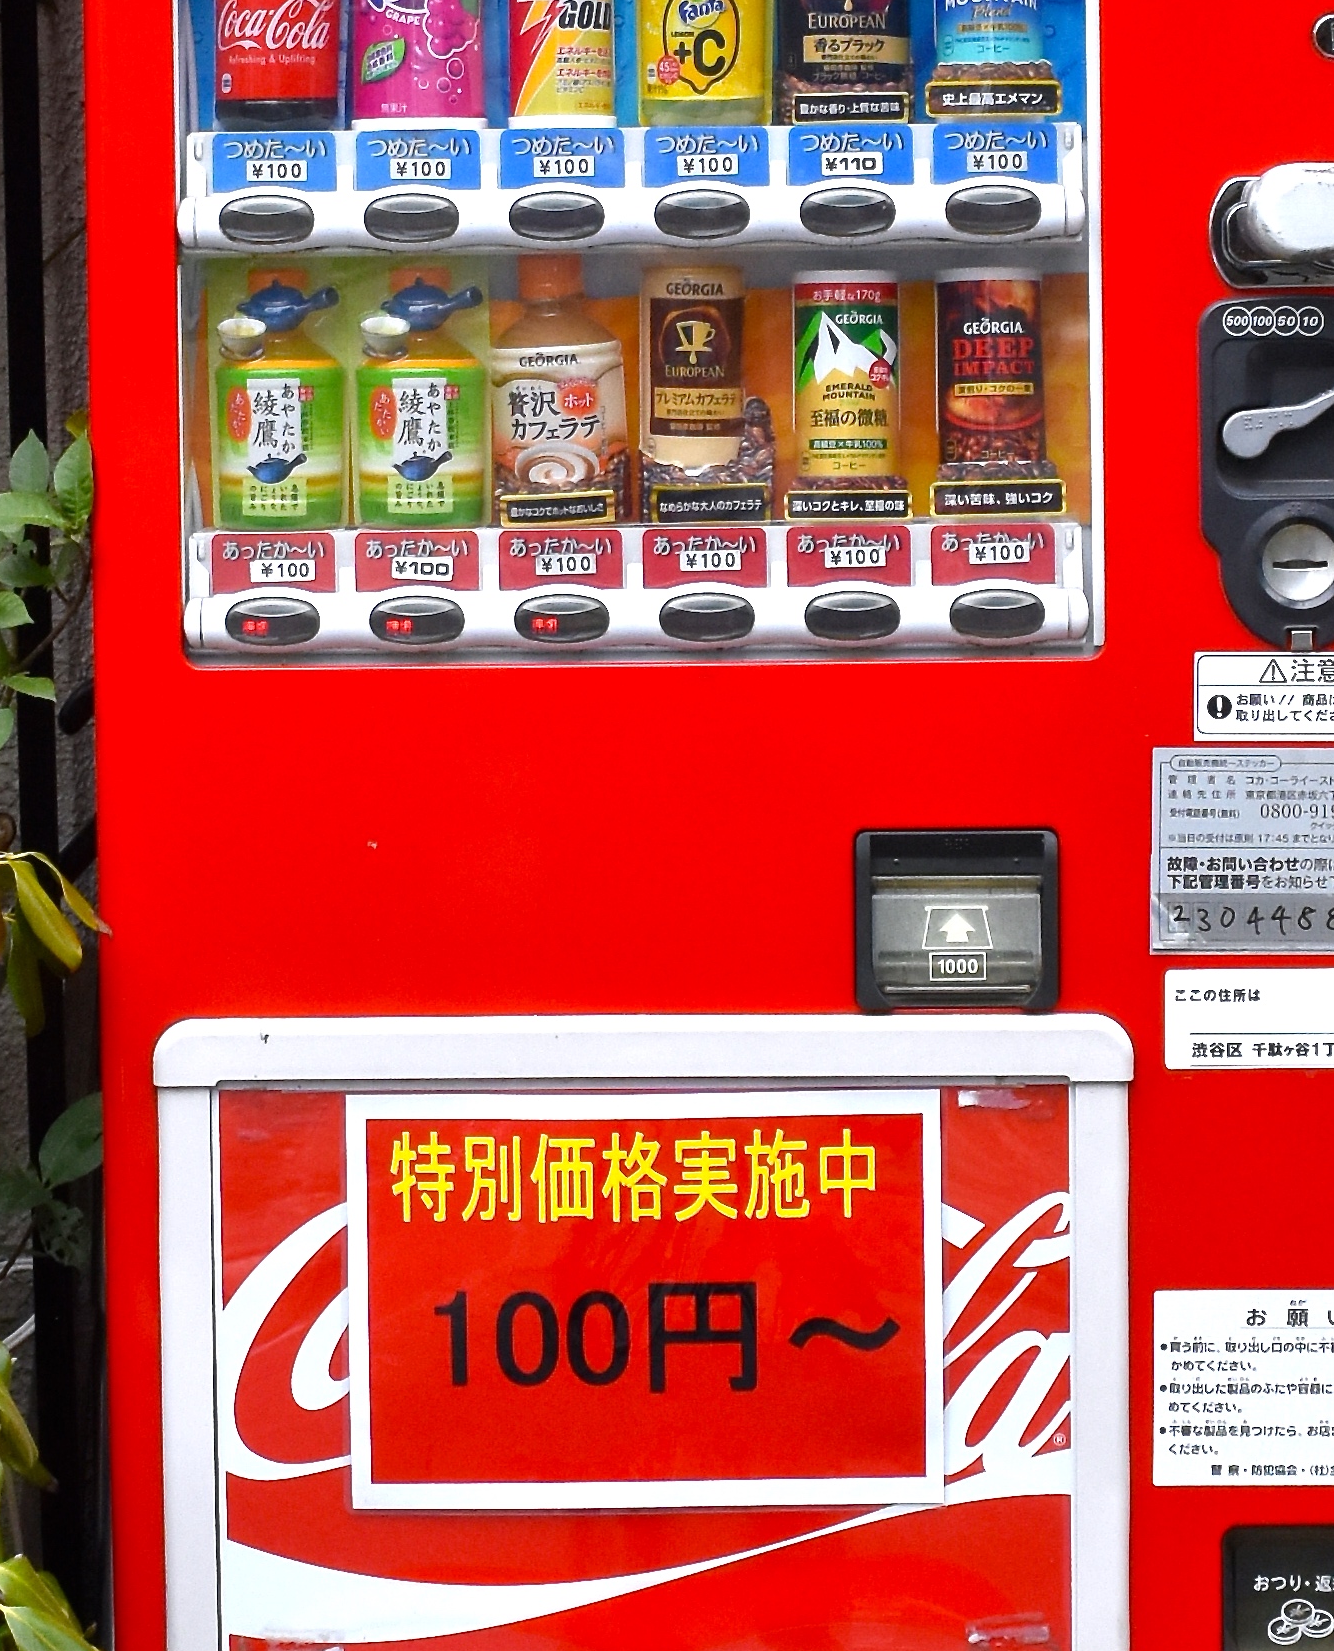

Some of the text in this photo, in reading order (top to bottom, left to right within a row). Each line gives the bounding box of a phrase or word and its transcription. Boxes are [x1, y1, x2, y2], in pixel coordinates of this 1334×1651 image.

[385, 8, 421, 26] GRAPE
[558, 0, 611, 31] GOLD
[807, 12, 886, 30] EUROPEAN
[268, 55, 276, 64] &
[278, 54, 316, 66] Uplifting
[396, 161, 446, 177] ¥100
[539, 159, 590, 175] ¥100
[683, 157, 734, 173] ¥100
[825, 156, 877, 172] ¥110
[973, 154, 1023, 170] ¥100
[252, 163, 302, 179] ¥100
[1226, 315, 1319, 328] 500 100 50 10
[952, 337, 1035, 360] DEEP
[665, 364, 726, 378] EUROPEAN
[953, 360, 1035, 377] IMPACT
[825, 382, 874, 392] EMERALD
[564, 392, 595, 408] ホット
[656, 392, 737, 406] プレミアムカフェラテ
[822, 391, 876, 401] MOUNTAIN
[508, 390, 562, 419] 贅沢
[252, 389, 281, 449] 綾鷹
[280, 383, 296, 455] あやたか
[398, 387, 427, 447] 綾鷹
[427, 382, 443, 453] あやたか
[810, 408, 889, 428] 至福の微糖
[511, 414, 601, 441] カフェラテ
[980, 450, 1015, 459] コーヒー
[832, 461, 866, 470] コーヒー
[659, 500, 763, 514] なめらかな大人のカフェラテ
[685, 553, 737, 569] ¥100
[830, 549, 880, 565] ¥100
[975, 545, 1026, 562] ¥100
[261, 563, 310, 578] ¥100
[395, 562, 450, 576] ¥100
[541, 557, 592, 573] ¥100
[1257, 834, 1290, 843] 17:45
[937, 958, 979, 974] 1000
[1174, 988, 1261, 1003] ここの住所は
[1191, 1041, 1243, 1058] 渋谷区
[389, 1126, 878, 1225] 特別価格実施中
[1171, 1360, 1258, 1372] かめてください。
[1168, 1401, 1243, 1414] めてください。
[1168, 1444, 1219, 1456] ください。
